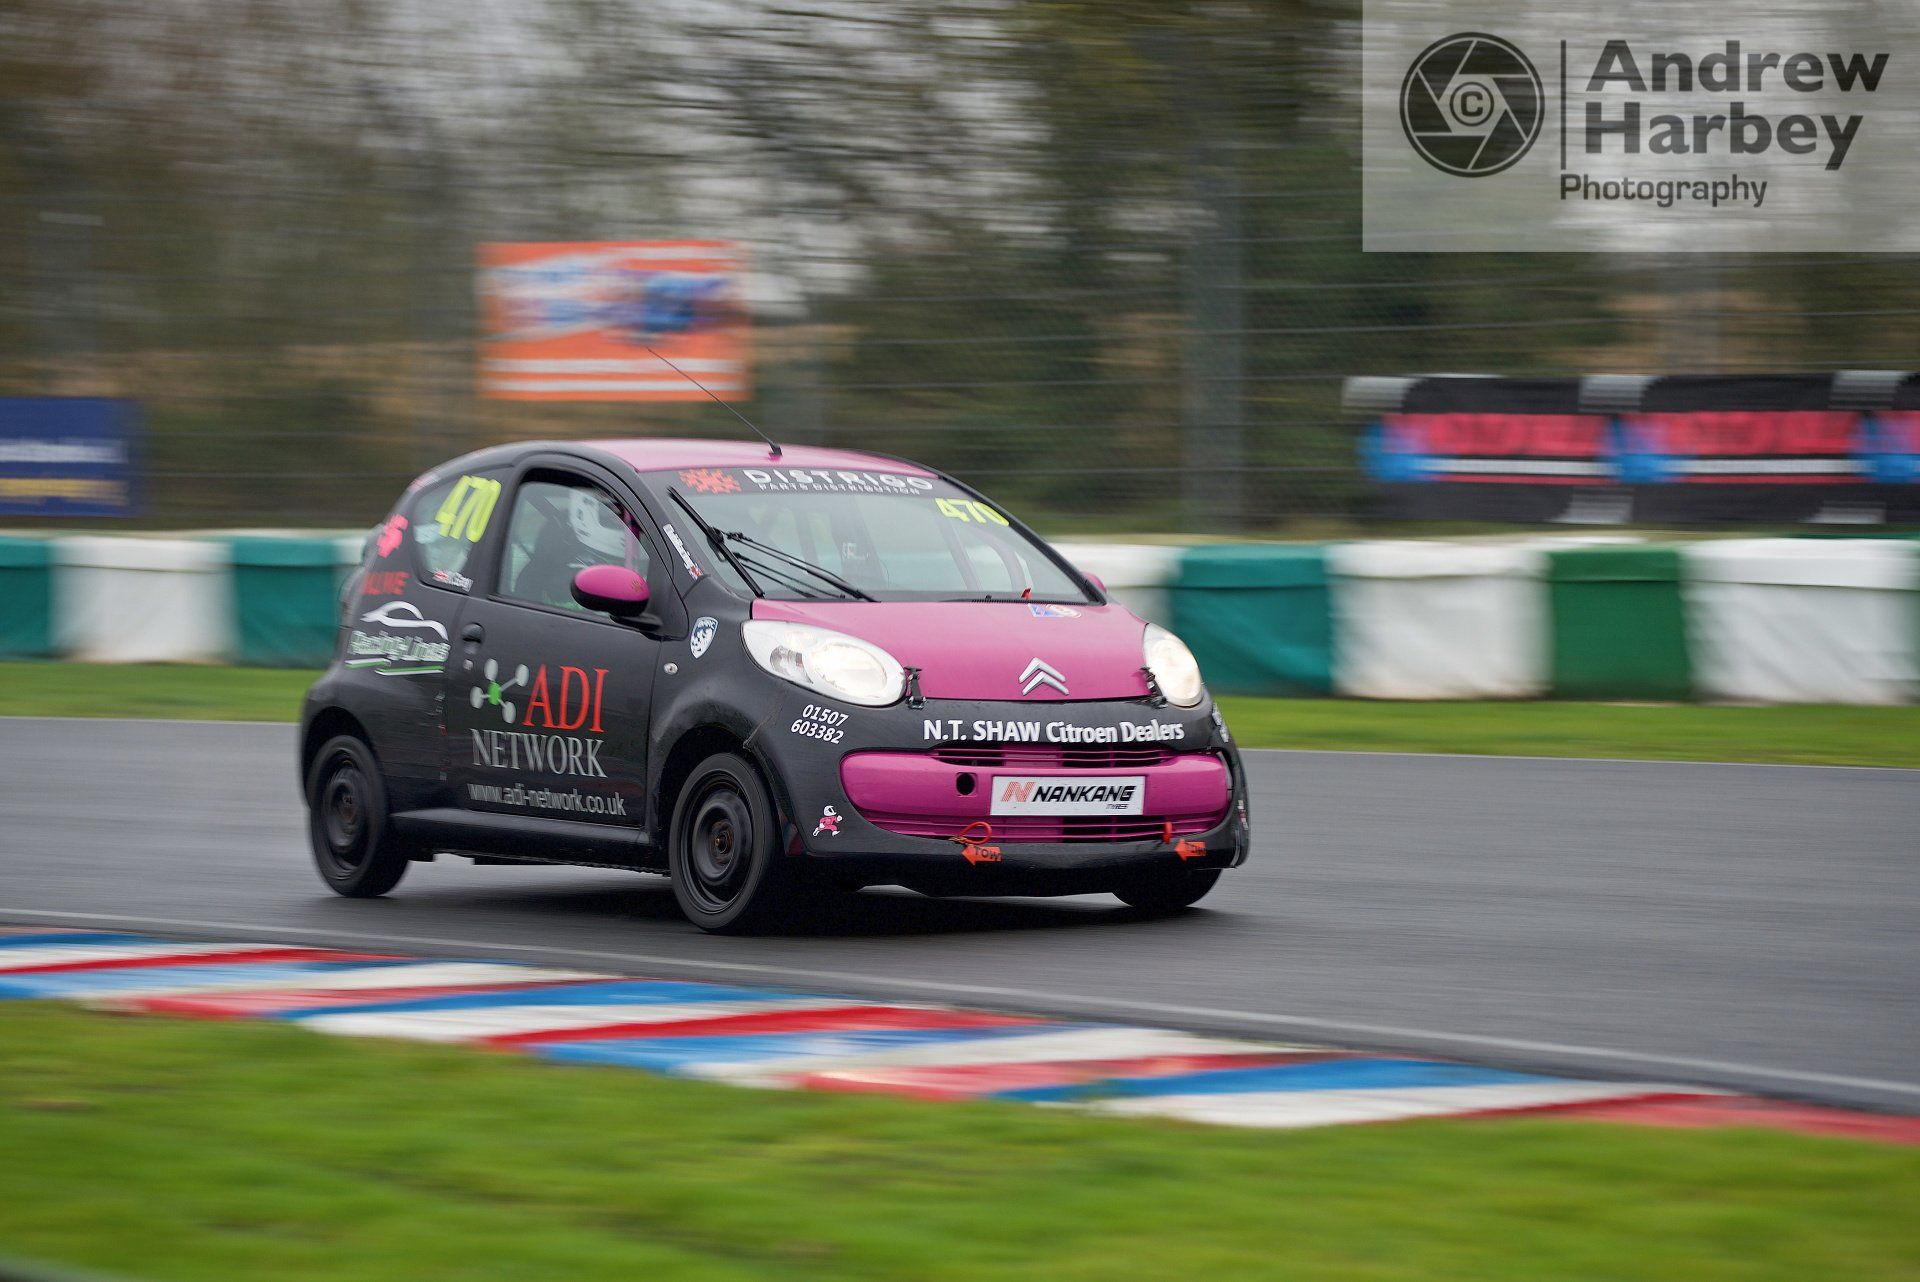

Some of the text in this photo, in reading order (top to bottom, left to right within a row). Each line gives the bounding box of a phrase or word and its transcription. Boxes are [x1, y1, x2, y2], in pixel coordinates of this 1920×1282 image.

[742, 469, 933, 490] DISTRIGO
[758, 483, 921, 496] PARTS DISTRIBUTION
[434, 474, 502, 543] 470
[934, 497, 1010, 527] 470
[521, 663, 610, 733] ADI
[802, 703, 849, 727] 01507
[790, 718, 845, 745] 603382
[923, 718, 1185, 743] N.T. SHAW Citroen Dealers
[468, 727, 609, 778] NETWORK
[466, 782, 627, 816] www.adi-network.co.uk
[1032, 785, 1137, 803] NANKANG
[973, 846, 1002, 862] TOW
